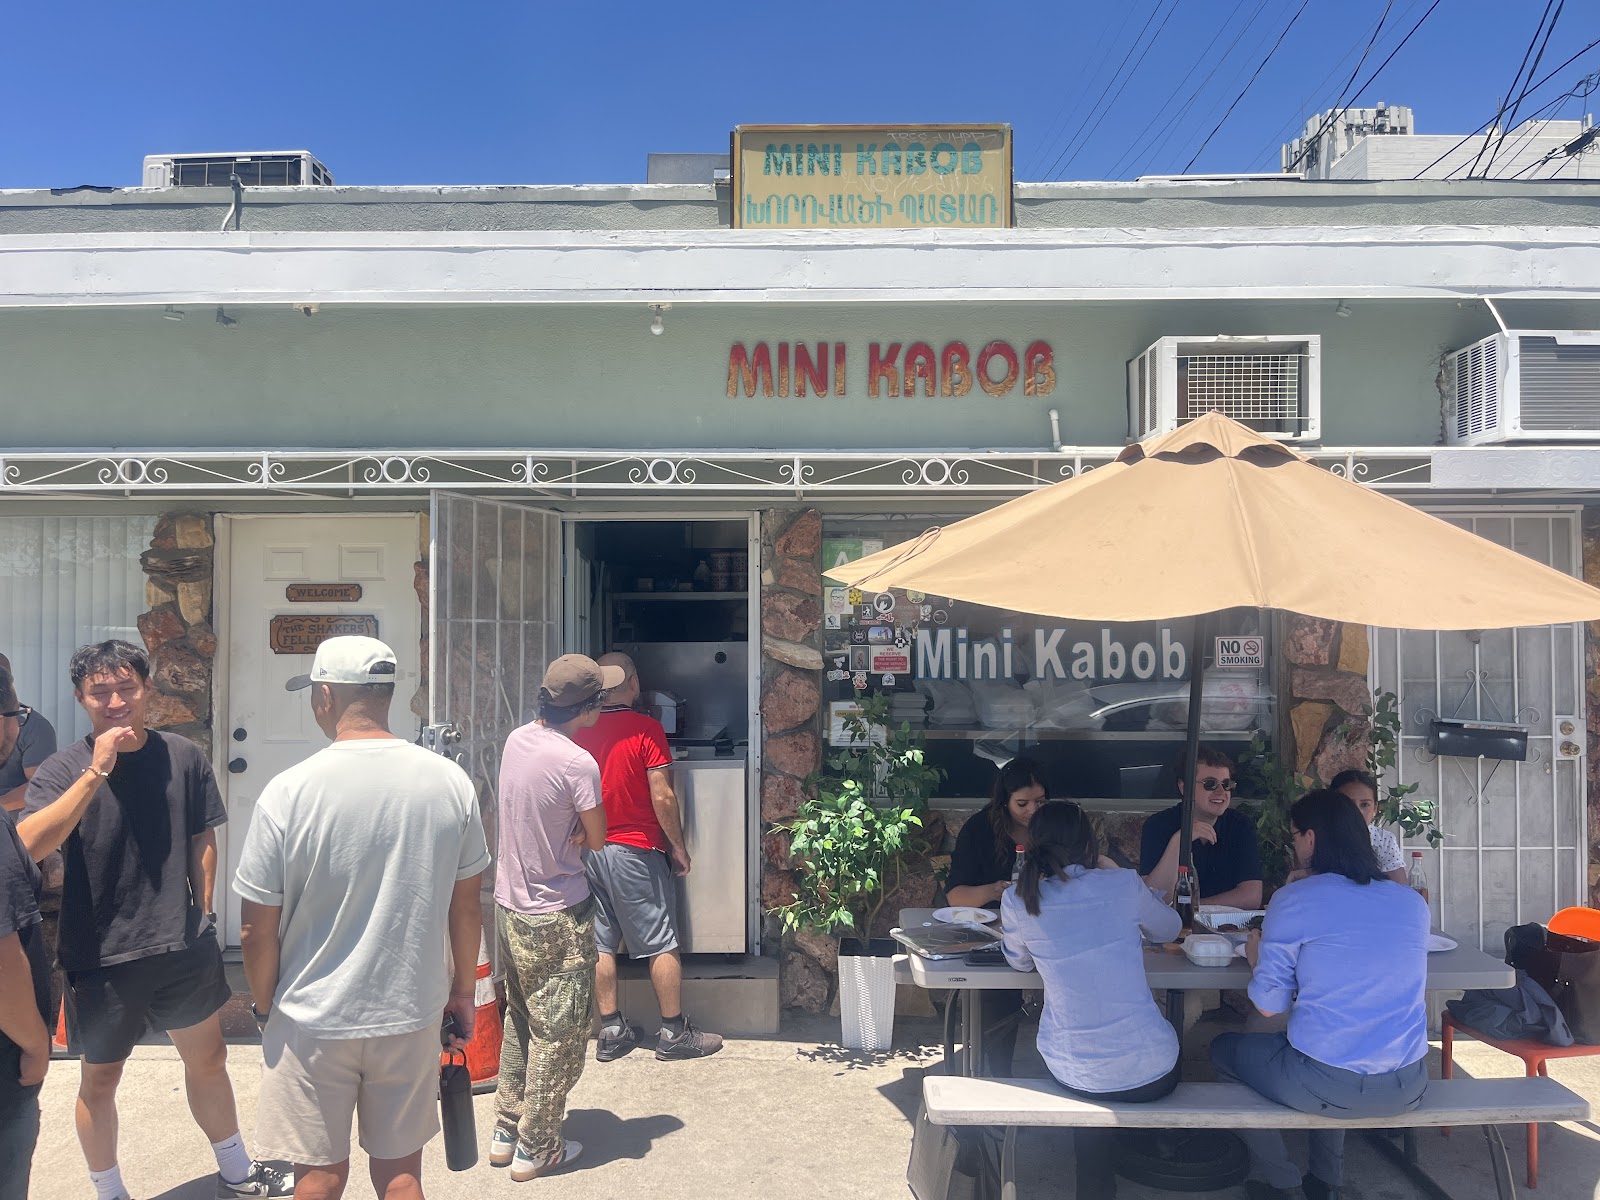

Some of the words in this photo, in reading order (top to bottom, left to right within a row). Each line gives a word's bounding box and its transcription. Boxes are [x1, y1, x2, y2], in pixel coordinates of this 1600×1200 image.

[764, 143, 842, 176] MINI
[856, 143, 983, 176] KABOB
[726, 341, 846, 398] MINI
[868, 341, 1057, 398] KABOB
[296, 588, 351, 597] WELCOME
[282, 624, 304, 633] THE
[307, 624, 364, 634] SHAKERS
[916, 628, 1013, 679] Mini
[1034, 628, 1187, 679] Kabob
[1220, 641, 1240, 654] NO
[1220, 656, 1261, 665] SMOKING
